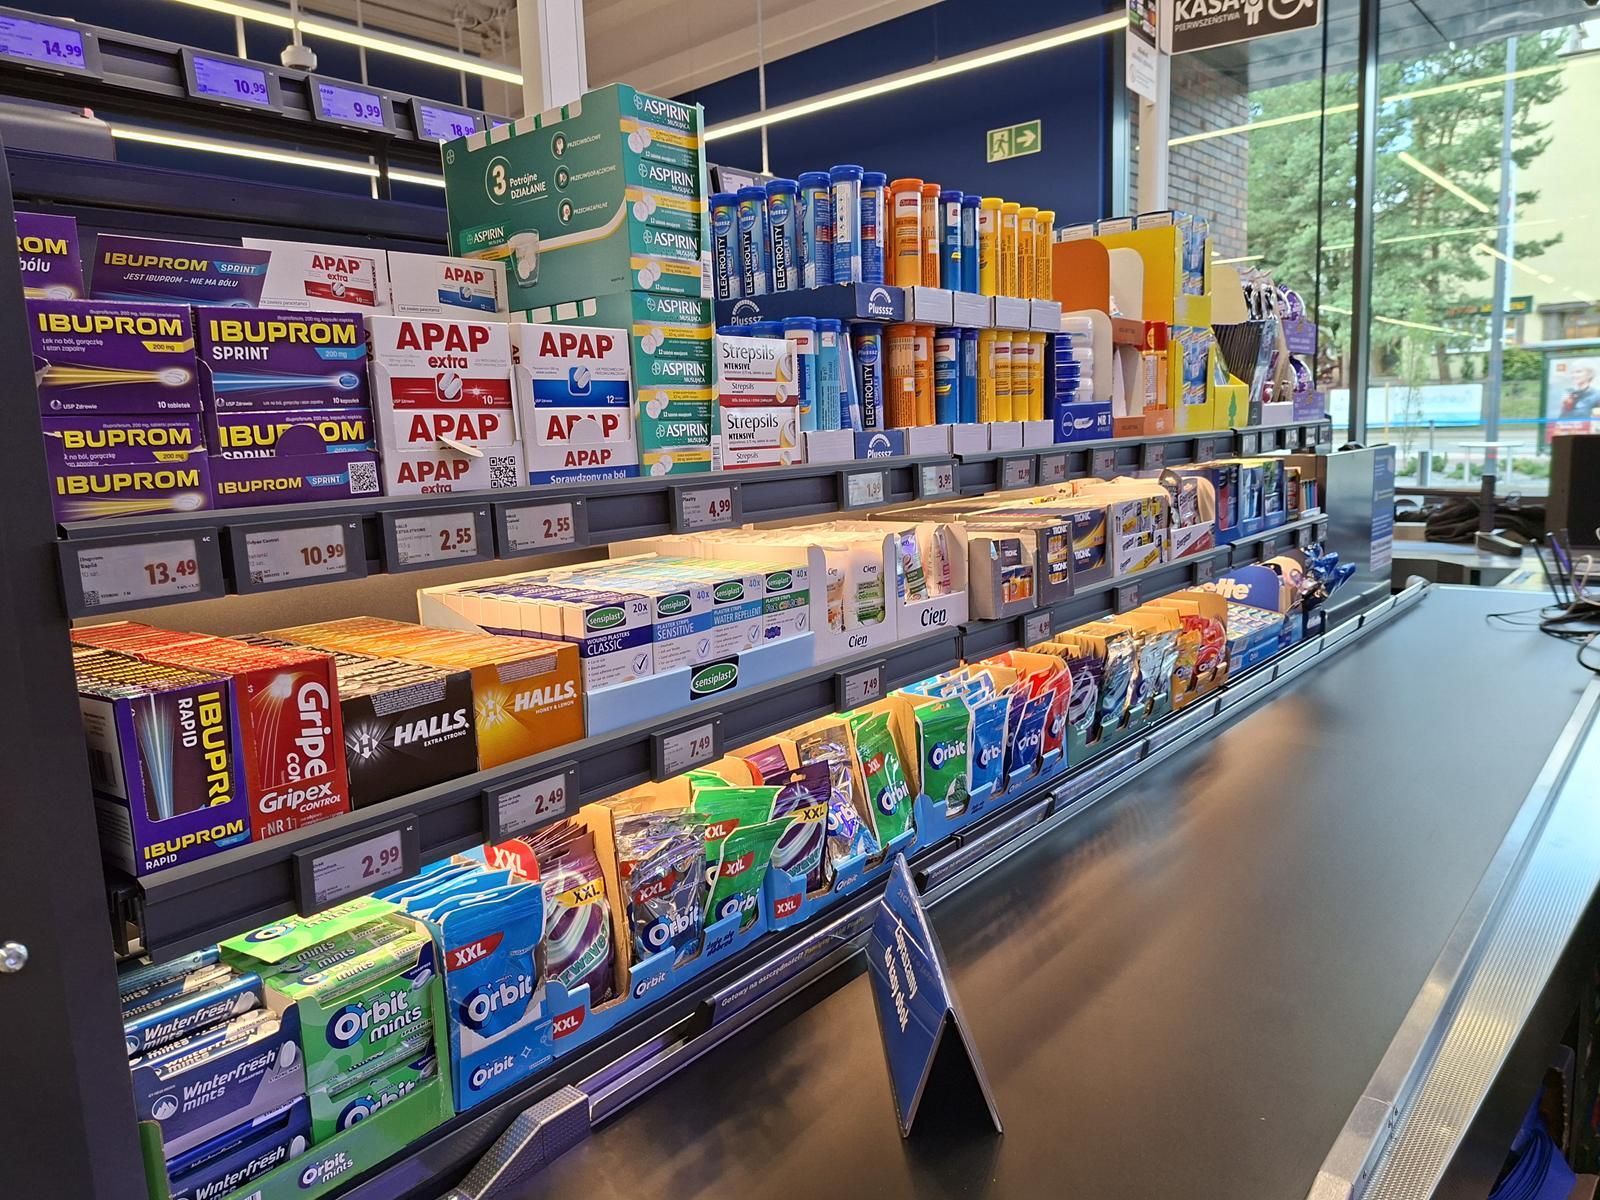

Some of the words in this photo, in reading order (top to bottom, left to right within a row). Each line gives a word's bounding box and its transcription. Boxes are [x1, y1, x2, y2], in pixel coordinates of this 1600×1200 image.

[1175, 0, 1239, 22] KASA
[1174, 13, 1241, 32] PIERWSZEŃSTWA
[42, 39, 83, 58] 14.99
[233, 78, 267, 95] 10.99
[353, 101, 382, 119] 9.99
[644, 98, 690, 123] ASPIRIN
[492, 164, 507, 196] 3
[509, 173, 538, 188] Potrójne
[649, 165, 694, 188] ASPIRIN
[511, 182, 547, 199] DZIAŁANIE
[473, 226, 505, 244] ASPIRIN
[654, 232, 698, 250] ASPIRIN
[104, 252, 209, 272] IBUPROM
[220, 264, 256, 274] SPRINT
[311, 254, 361, 275] APAP
[123, 273, 144, 281] JEST
[145, 274, 183, 284] IBUPROM
[190, 278, 203, 286] NIE
[204, 278, 217, 286] MA
[218, 277, 238, 287] BÓLU
[327, 272, 349, 283] extra
[444, 266, 485, 285] APAP
[658, 299, 701, 315] ASPIRIN
[38, 313, 183, 337] IBUPROM
[209, 320, 357, 345] IBUPROM
[397, 321, 490, 353] APAP
[539, 331, 613, 359] APAP
[212, 346, 269, 360] SPRINT
[428, 354, 468, 369] extra
[722, 342, 775, 363] Strepsils
[662, 362, 705, 376] ASPIRIN
[731, 382, 755, 391] Strepsils
[158, 401, 167, 409] 10
[482, 395, 493, 405] 10
[606, 395, 615, 404] 12
[408, 414, 499, 442] APAP
[666, 422, 708, 437] ASPIRIN
[727, 413, 779, 432] Strepsils
[63, 427, 192, 449] BUPROM
[564, 449, 612, 467] APAP
[736, 451, 759, 460] Strepsils
[397, 459, 470, 484] APAP
[550, 473, 601, 484] Sprawdzony
[603, 472, 612, 481] na
[613, 470, 627, 479] ból
[938, 473, 951, 489] 3.99
[56, 469, 199, 495] IBUPROM
[218, 477, 302, 494] IBUPROM
[312, 475, 341, 485] SPRINT
[421, 483, 452, 493] extra
[708, 498, 731, 518] 4.99
[542, 516, 570, 539] 2.55
[439, 527, 472, 551] 2.55
[300, 543, 344, 567] 10.99
[144, 559, 198, 586] 13.49
[796, 570, 807, 579] 40x
[863, 565, 877, 573] Cien
[748, 578, 761, 588] 40x
[767, 576, 791, 589] sensiplast
[696, 590, 710, 600] 40x
[714, 586, 742, 599] sensiplast
[632, 603, 648, 614] 20x
[658, 598, 690, 613] sensiplast
[589, 610, 623, 626] sensiplast
[713, 613, 731, 625] WATER
[731, 606, 762, 621] REPELLENT
[920, 606, 948, 627] Cien
[657, 622, 674, 630] PLASTER
[657, 623, 695, 641] SENSITIVE
[587, 637, 605, 646] WOUND
[606, 631, 630, 641] PLASTERS
[587, 640, 623, 656] CLASSIC
[848, 634, 868, 648] Cien
[694, 668, 732, 689] sensiplast
[863, 677, 878, 696] 7.49
[535, 705, 551, 715] HONEY
[554, 700, 574, 711] LEMON
[178, 697, 198, 748] RAPID
[423, 737, 443, 747] EXTRA
[443, 730, 467, 743] STRONG
[690, 735, 710, 758] 7.49
[931, 740, 966, 766] Orbit
[259, 781, 333, 813] Gripex
[300, 794, 342, 813] CONTROL
[534, 787, 564, 815] 2.49
[802, 808, 825, 821] XXL
[267, 819, 285, 836] NR
[286, 816, 293, 830] 1
[143, 819, 244, 860] IBUPROM
[145, 853, 178, 870] RAPID
[361, 845, 400, 879] 2.99
[492, 847, 528, 876] XXL
[725, 858, 745, 875] XXL
[639, 880, 667, 902] XXL
[836, 873, 858, 892] Orbit
[572, 884, 601, 904] XXL
[776, 899, 797, 915] XXL
[648, 906, 700, 946] Orbit
[296, 940, 336, 962] mints
[317, 947, 356, 969] mints
[454, 942, 487, 967] XXL
[336, 959, 376, 982] mints
[636, 971, 667, 996] Orbit
[468, 975, 533, 1021] Orbit
[721, 986, 748, 1007] Gotowy
[748, 981, 758, 991] na
[143, 998, 235, 1042] Winterfresh
[333, 988, 409, 1041] Orbit
[553, 1015, 579, 1033] XXL
[368, 1006, 422, 1044] mints
[142, 1029, 185, 1051] mints
[182, 1049, 277, 1101] Winterfresh
[472, 1054, 515, 1087] Orbit
[181, 1086, 226, 1113] mints
[195, 1146, 286, 1200] Winterfresh
[301, 1151, 347, 1185] Orbit
[321, 1158, 354, 1184] mints
